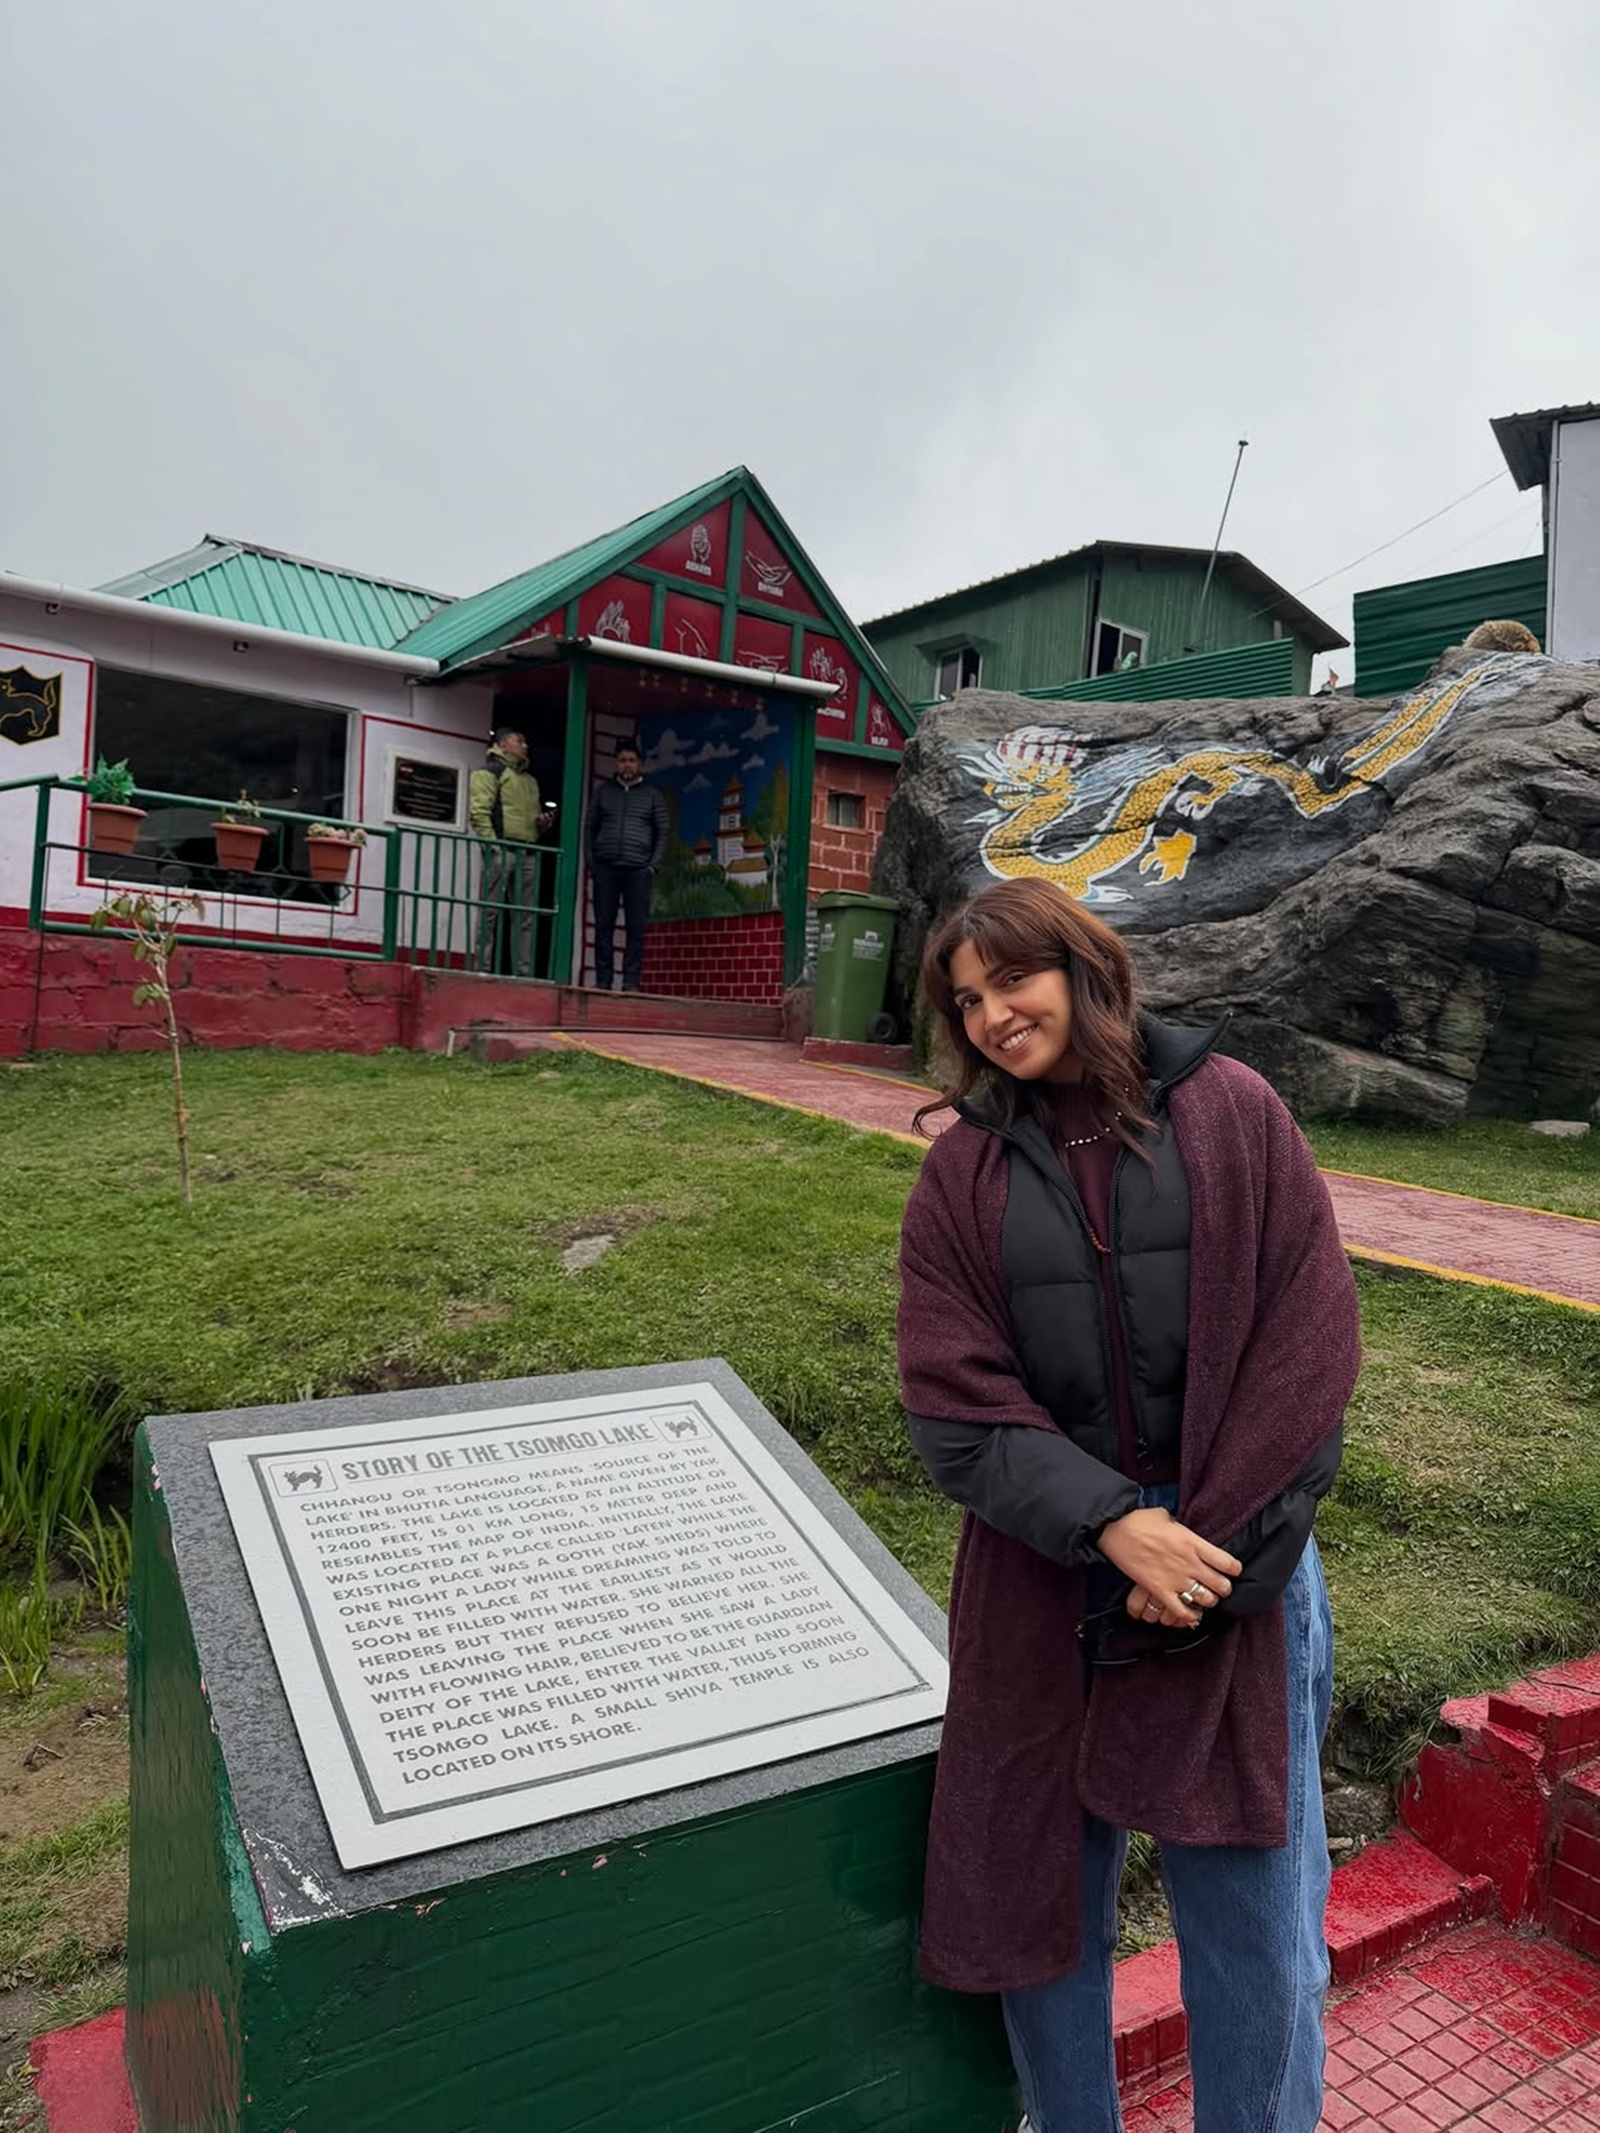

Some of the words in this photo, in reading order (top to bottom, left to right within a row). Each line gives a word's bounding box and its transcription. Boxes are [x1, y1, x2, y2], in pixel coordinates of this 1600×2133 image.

[299, 1491, 392, 1512] CHHANGU
[401, 1487, 427, 1499] OR
[432, 1474, 520, 1494] TSONGMO
[528, 1465, 583, 1480] MEANS
[656, 1450, 678, 1460] OF
[681, 1445, 710, 1456] THE
[304, 1511, 353, 1526] LAKE'
[357, 1507, 380, 1519] IN
[383, 1498, 451, 1515] BHUTIA
[453, 1483, 552, 1505] LANGUAGE,
[555, 1480, 567, 1490] A
[568, 1472, 616, 1487] NAME
[618, 1464, 666, 1479] GIVEN
[668, 1461, 688, 1471] BY
[688, 1456, 720, 1468] YAK
[340, 1453, 419, 1480] STORY
[424, 1448, 454, 1469] OF
[457, 1442, 504, 1464] THE
[502, 1430, 598, 1457] TSOMGO
[597, 1422, 654, 1444] LAKE
[309, 1520, 396, 1540] HERDERS.
[399, 1513, 435, 1527] THE
[439, 1506, 483, 1521] LAKE
[487, 1503, 504, 1514] IS
[507, 1492, 579, 1511] LOCATED
[584, 1488, 603, 1499] AT
[608, 1483, 632, 1495] AN
[636, 1472, 703, 1491] ALTITUDE
[707, 1468, 728, 1478] OF
[315, 1537, 371, 1555] 12400
[379, 1530, 423, 1546] FEET,
[430, 1527, 448, 1538] IS
[454, 1522, 475, 1534] 01
[484, 1517, 513, 1529] KM
[518, 1508, 574, 1524] LONG,
[579, 1502, 600, 1513] 15
[606, 1493, 655, 1510] METER
[660, 1486, 698, 1500] DEEP
[704, 1480, 738, 1493] AND
[320, 1545, 423, 1570] RESEMBLES
[426, 1539, 462, 1553] THE
[467, 1532, 505, 1547] MAP
[511, 1527, 534, 1540] OF
[597, 1504, 675, 1525] INITIALLY,
[675, 1498, 708, 1511] THE
[709, 1492, 748, 1505] LAKE
[324, 1569, 369, 1585] WAS
[372, 1556, 454, 1578] LOCATED
[459, 1551, 479, 1564] AT
[485, 1549, 499, 1560] A
[500, 1539, 554, 1557] PLACE
[556, 1529, 616, 1547] CALLED
[676, 1509, 728, 1525] WHILE
[726, 1504, 758, 1517] THE
[332, 1577, 421, 1601] EXISTING
[428, 1567, 484, 1585] PLACE
[488, 1559, 530, 1575] WAS
[537, 1556, 550, 1567] A
[555, 1546, 605, 1563] GOTH
[611, 1537, 650, 1555] (YAK
[653, 1527, 712, 1545] SHEDS)
[713, 1516, 769, 1534] WHERE
[337, 1600, 382, 1617] ONE
[386, 1588, 448, 1609] NIGHT
[454, 1586, 469, 1598] A
[471, 1577, 517, 1594] LADY
[520, 1566, 578, 1585] WHILE
[580, 1549, 671, 1575] DREAMING
[672, 1542, 711, 1557] WAS
[710, 1534, 754, 1550] TOLD
[753, 1529, 777, 1541] TO
[343, 1614, 405, 1634] LEAVE
[411, 1605, 456, 1622] THIS
[464, 1593, 521, 1613] PLACE
[529, 1587, 549, 1602] AT
[557, 1580, 593, 1595] THE
[598, 1564, 672, 1588] EARLIEST
[680, 1559, 703, 1573] AS
[706, 1555, 723, 1566] IT
[727, 1543, 788, 1562] WOULD
[350, 1630, 412, 1651] SOON
[415, 1624, 442, 1639] BE
[444, 1613, 506, 1634] FILLED
[508, 1603, 559, 1622] WITH
[560, 1592, 626, 1611] WATER.
[628, 1583, 663, 1599] SHE
[663, 1569, 736, 1591] WARNED
[739, 1563, 769, 1577] ALL
[766, 1556, 800, 1570] THE
[357, 1642, 447, 1669] HERDERS
[453, 1633, 491, 1651] BUT
[498, 1623, 545, 1641] THEY
[553, 1607, 630, 1631] REFUSED
[634, 1601, 662, 1614] TO
[666, 1586, 733, 1608] BELIEVE
[735, 1579, 776, 1594] HER.
[778, 1570, 811, 1585] SHE
[362, 1667, 410, 1686] WAS
[418, 1649, 505, 1676] LEAVING
[512, 1640, 551, 1657] THE
[557, 1628, 613, 1649] PLACE
[617, 1615, 674, 1636] WHEN
[679, 1607, 715, 1623] SHE
[718, 1598, 756, 1615] SAW
[763, 1595, 778, 1606] A
[779, 1584, 821, 1602] LADY
[369, 1683, 426, 1705] WITH
[427, 1665, 522, 1694] FLOWING
[524, 1655, 579, 1674] HAIR,
[579, 1636, 662, 1663] BELIEVED
[661, 1631, 689, 1645] TO
[688, 1625, 714, 1639] BE
[710, 1618, 747, 1634] THE
[745, 1599, 834, 1627] GUARDIAN
[378, 1700, 435, 1724] DEITY
[444, 1693, 472, 1710] OF
[477, 1684, 519, 1703] THE
[523, 1673, 579, 1694] LAKE,
[583, 1659, 644, 1681] ENTER
[645, 1650, 684, 1667] THE
[684, 1635, 748, 1658] VALLEY
[753, 1627, 792, 1644] AND
[795, 1614, 846, 1634] SOON
[384, 1723, 428, 1743] THE
[430, 1709, 494, 1734] PLACE
[495, 1699, 543, 1719] WAS
[545, 1686, 608, 1709] FILLED
[609, 1674, 661, 1694] WITH
[661, 1660, 730, 1683] WATER,
[727, 1648, 778, 1667] THUS
[777, 1630, 858, 1656] FORMING
[391, 1732, 489, 1763] TSOMGO
[500, 1718, 559, 1740] LAKE.
[570, 1711, 586, 1725] A
[593, 1696, 657, 1719] SMALL
[664, 1680, 724, 1702] SHIVA
[727, 1663, 795, 1687] TEMPLE
[800, 1657, 821, 1670] IS
[827, 1646, 870, 1664] ALSO
[401, 1752, 497, 1785] LOCATED
[499, 1743, 535, 1761] ON
[535, 1735, 568, 1753] ITS
[568, 1720, 642, 1746] SHORE.
